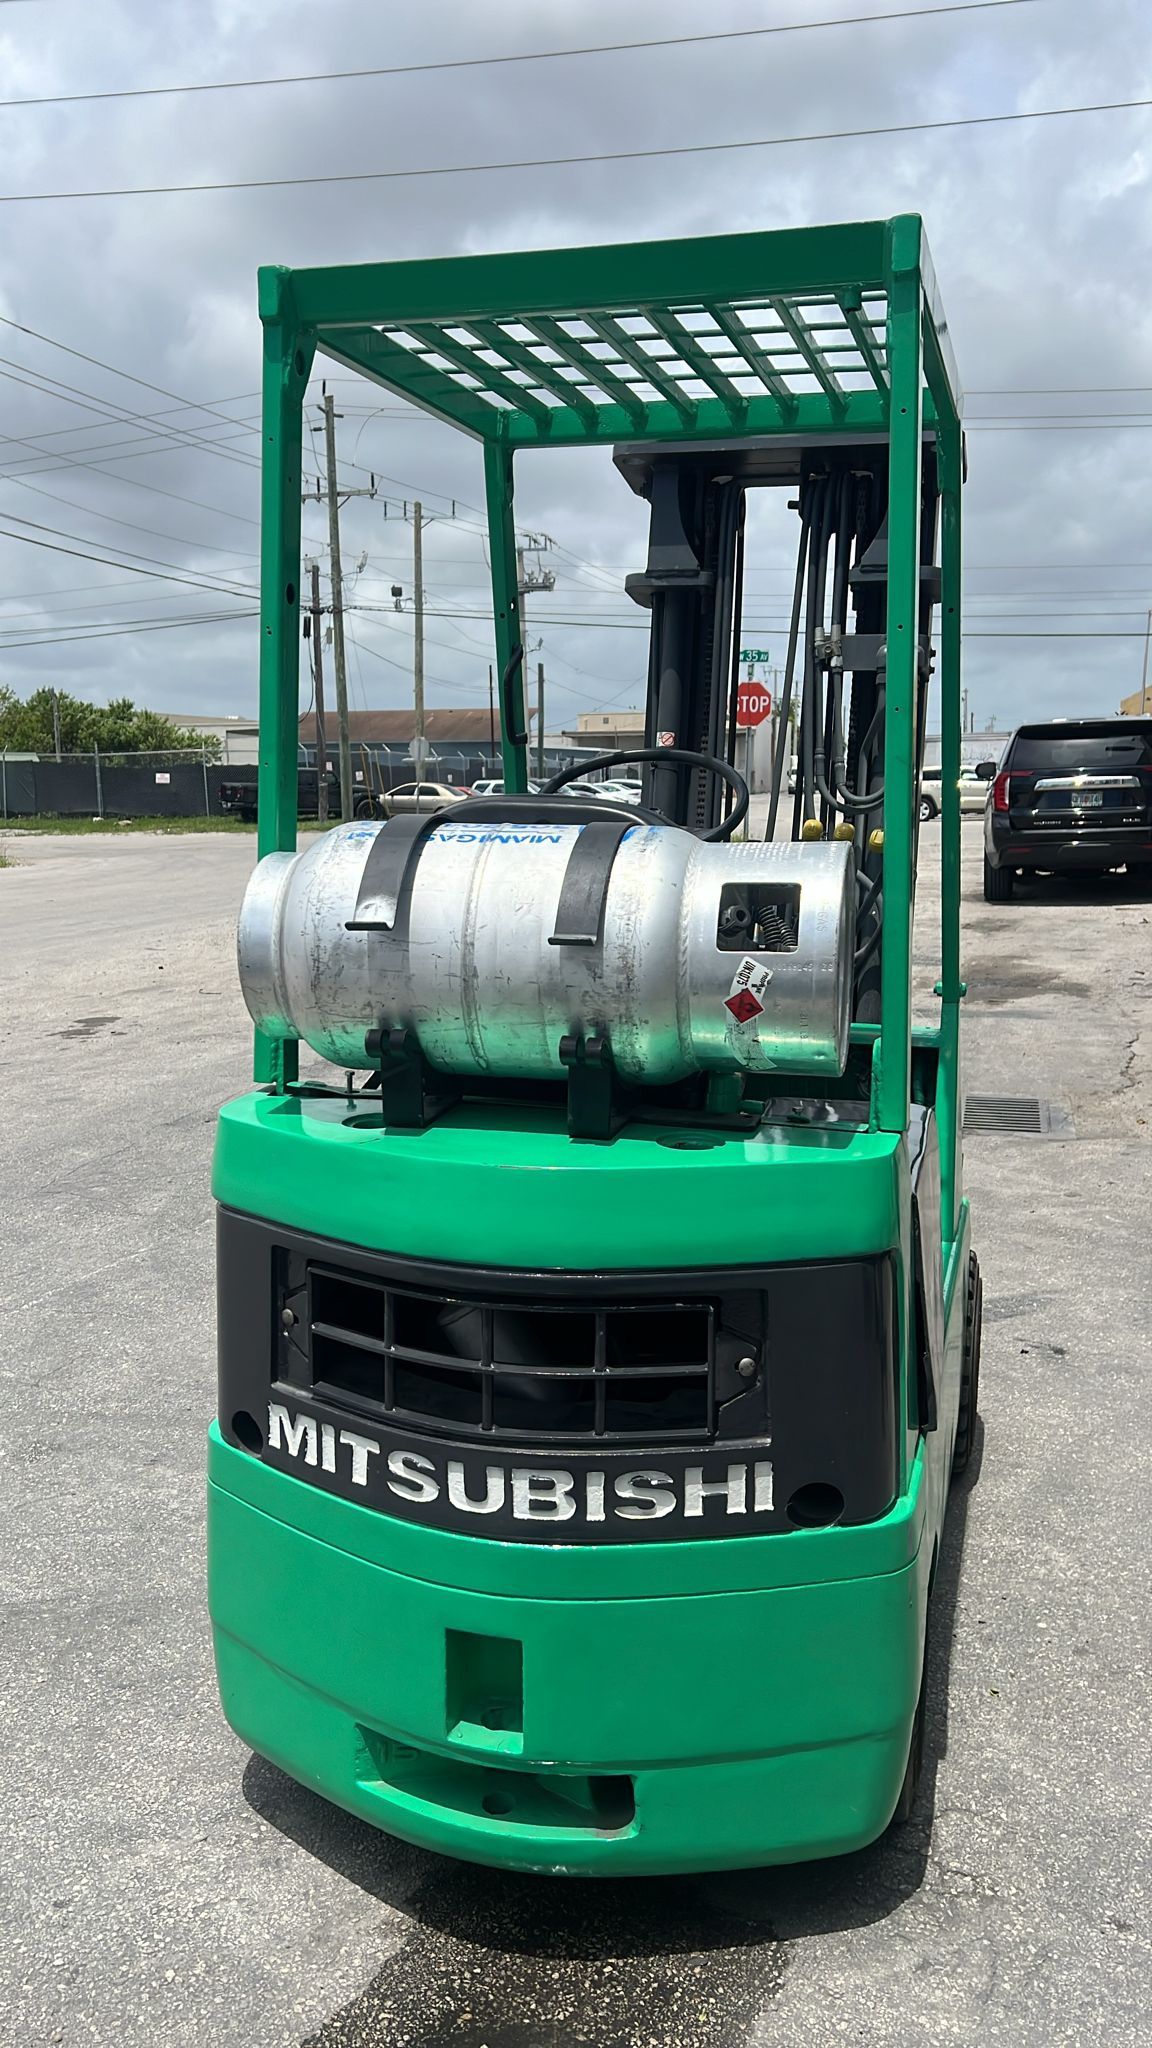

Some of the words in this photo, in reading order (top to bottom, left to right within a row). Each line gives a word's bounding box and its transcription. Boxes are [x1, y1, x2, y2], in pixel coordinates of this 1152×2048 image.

[746, 650, 759, 661] 35
[737, 961, 756, 987] UN1075
[268, 1402, 775, 1522] MITSUBISHI
